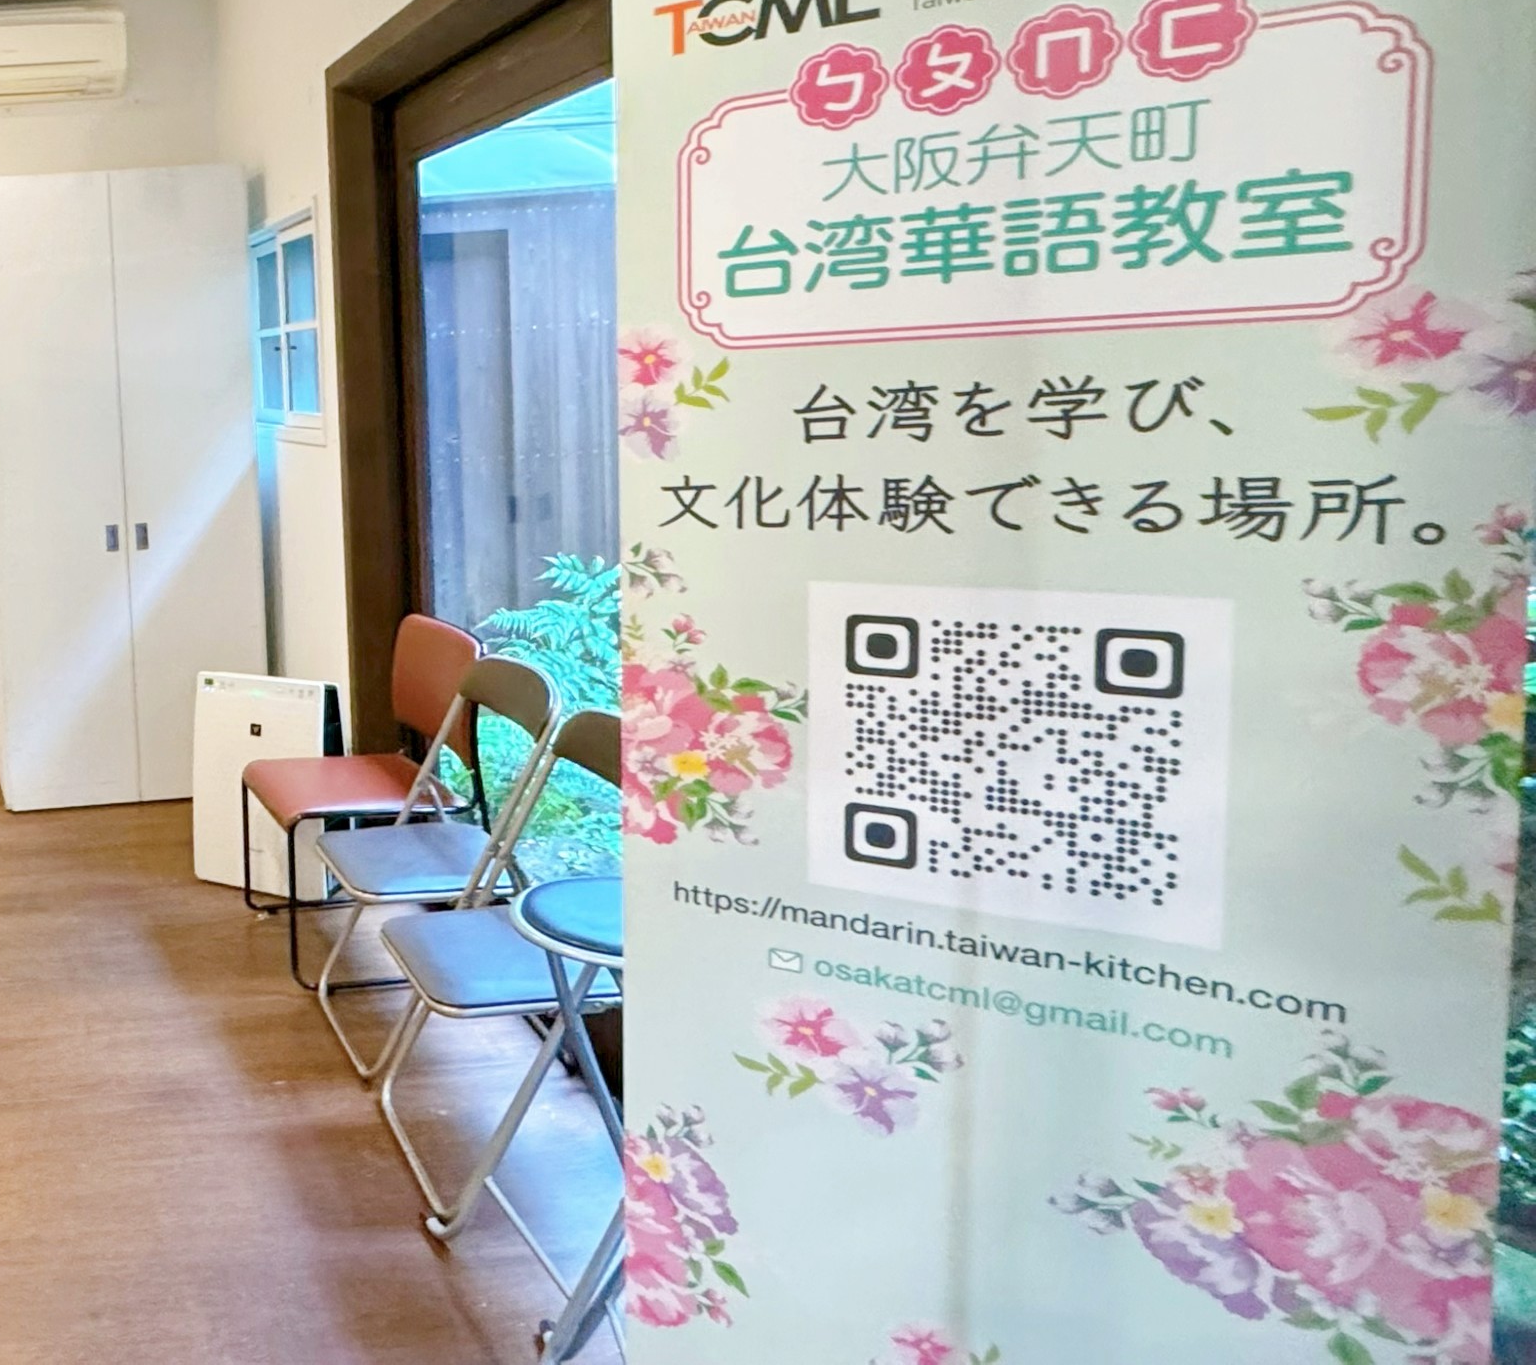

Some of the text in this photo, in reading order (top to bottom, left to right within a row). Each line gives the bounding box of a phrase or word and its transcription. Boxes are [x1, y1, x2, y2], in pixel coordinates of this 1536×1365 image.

[821, 98, 1213, 203] 大阪弁天町
[716, 168, 1355, 302] 台湾華語教室
[791, 375, 1238, 447] 台湾を学び、
[655, 472, 1457, 548] 文化体験できる場所。
[672, 879, 1349, 1026] https://mandarin.taiwan-kitchen.com
[812, 952, 1235, 1061] osakatcml@gmail.com
